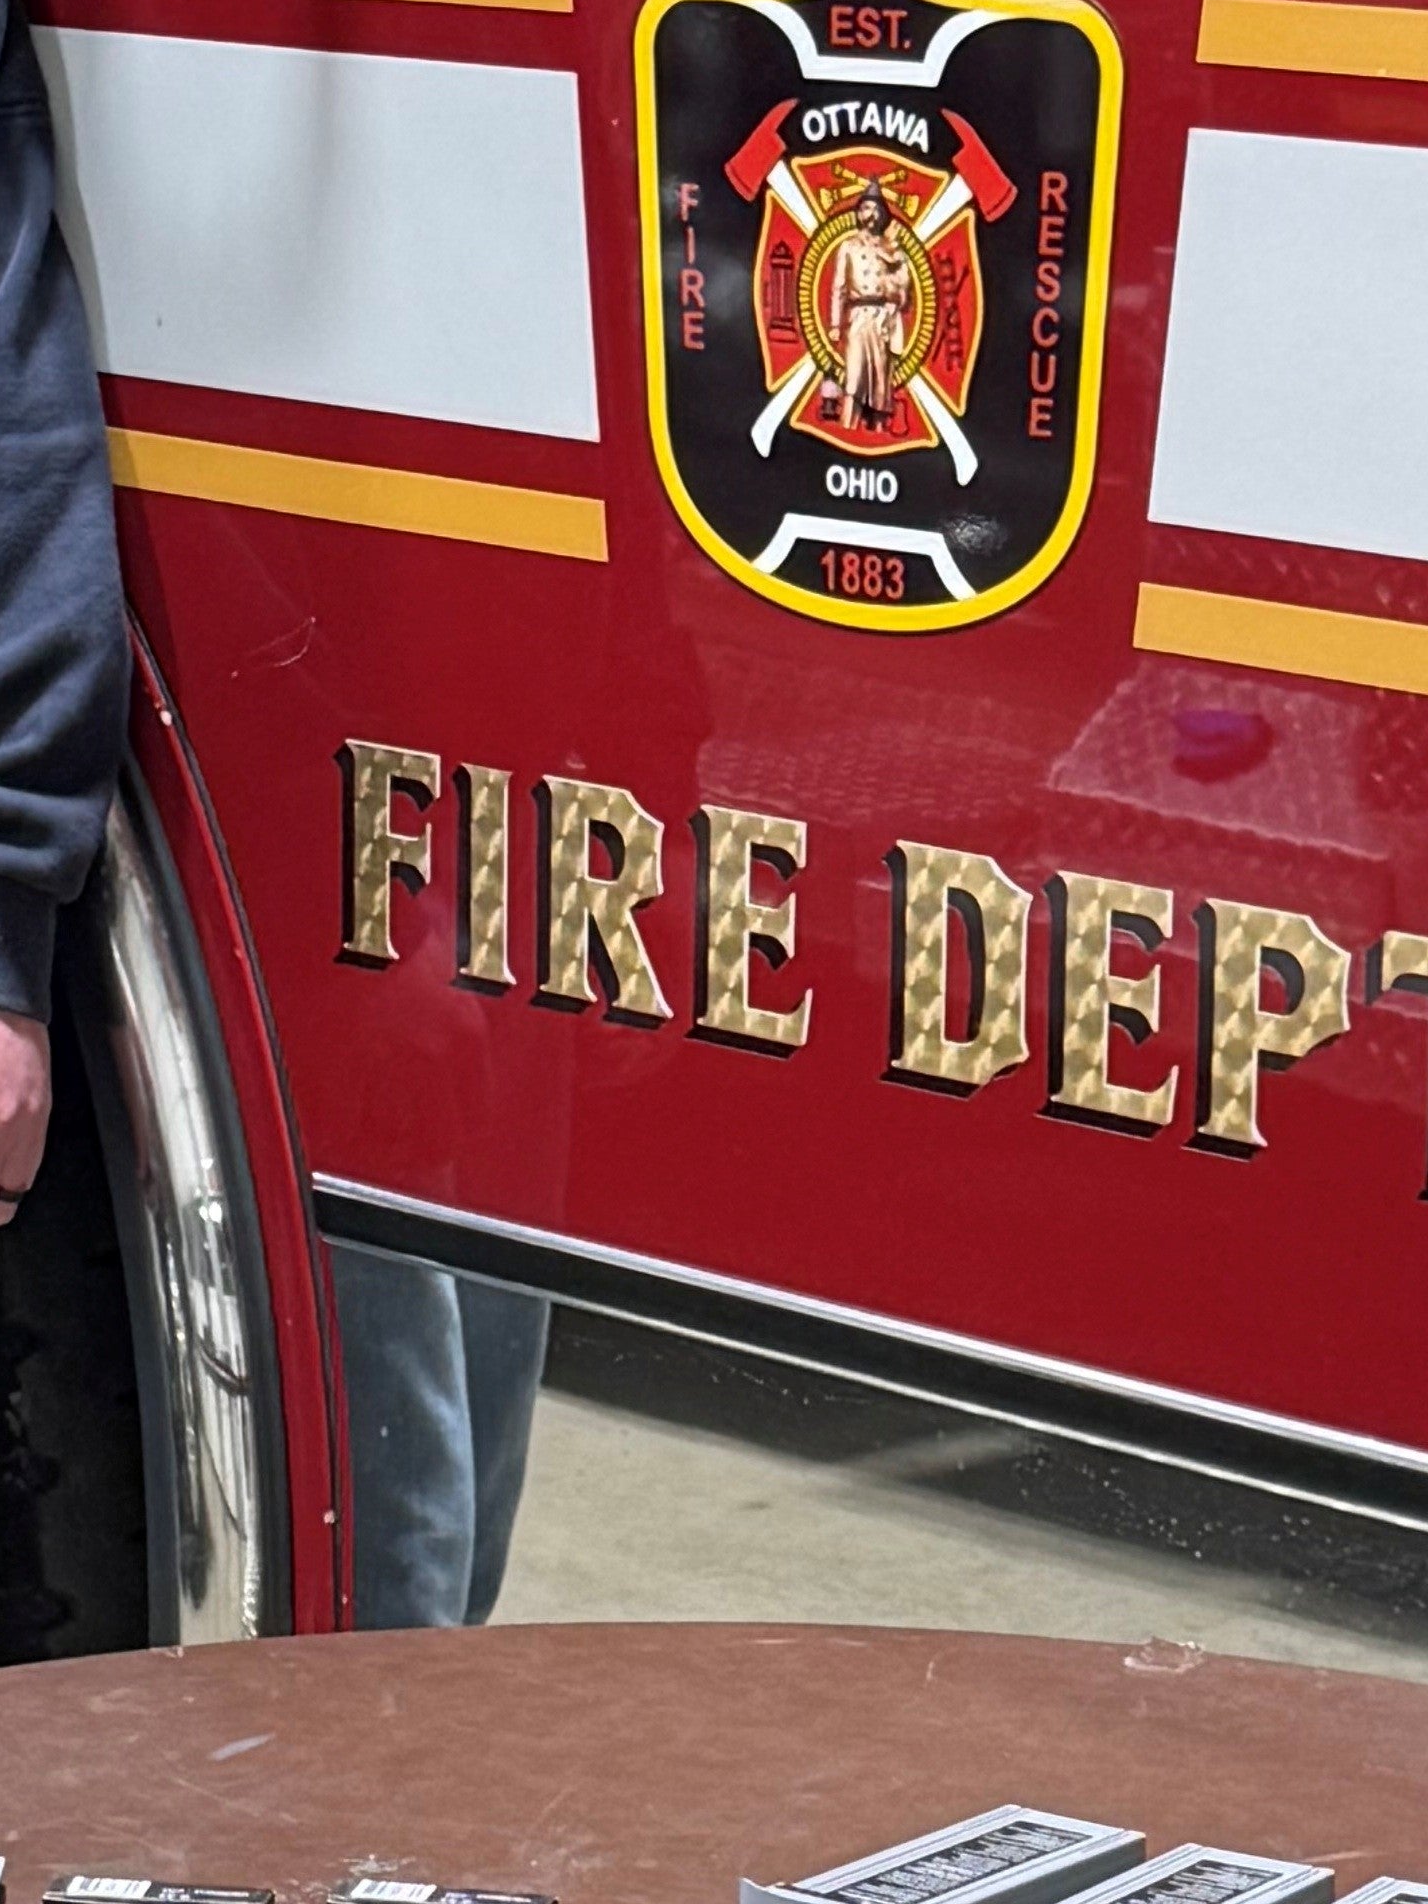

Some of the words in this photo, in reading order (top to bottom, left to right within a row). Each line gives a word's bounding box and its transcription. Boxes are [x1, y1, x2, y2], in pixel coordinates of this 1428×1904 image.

[828, 5, 912, 50] EST.
[801, 99, 930, 153] OTTAWA
[676, 183, 705, 352] FIRE
[1027, 170, 1070, 438] RESCUE
[824, 463, 899, 504] OHIO
[820, 549, 906, 600] 1883
[334, 737, 814, 1059] FIRE
